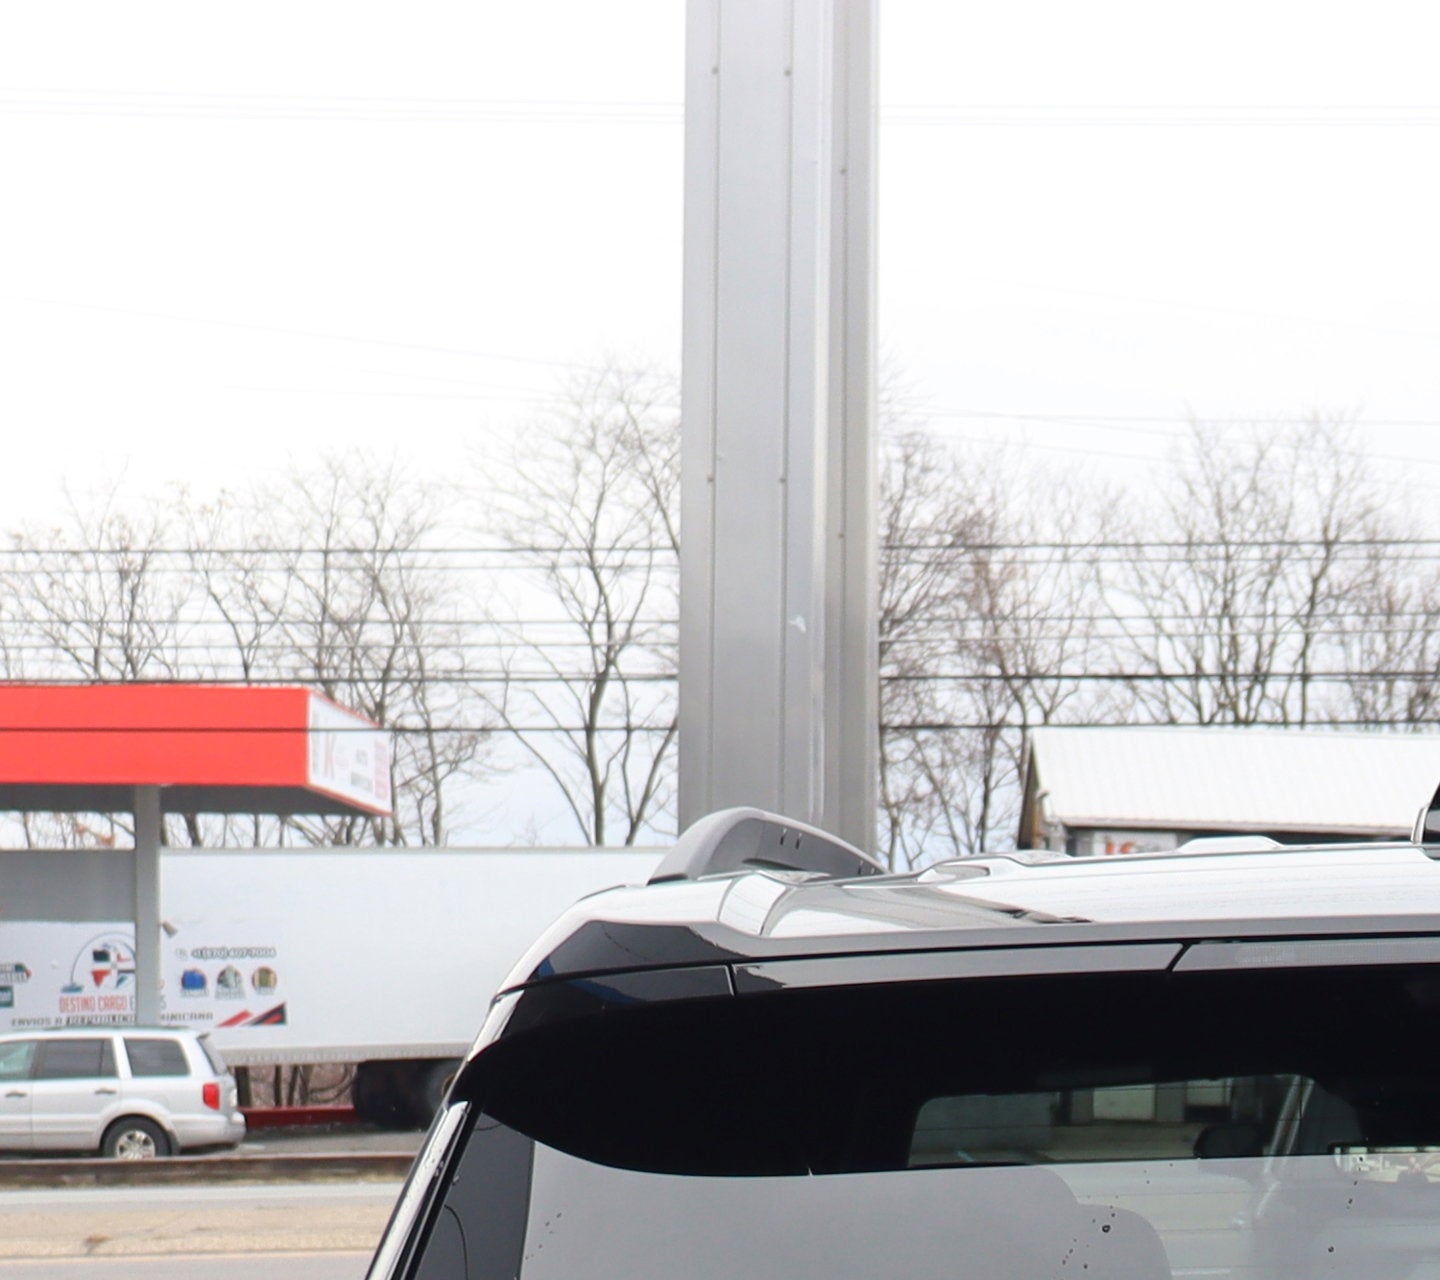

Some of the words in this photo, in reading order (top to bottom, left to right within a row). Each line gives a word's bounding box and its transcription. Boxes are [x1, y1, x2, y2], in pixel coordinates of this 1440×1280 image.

[59, 996, 95, 1013] DESTINO
[99, 995, 127, 1011] CARGO
[12, 1017, 50, 1026] ENVIOS
